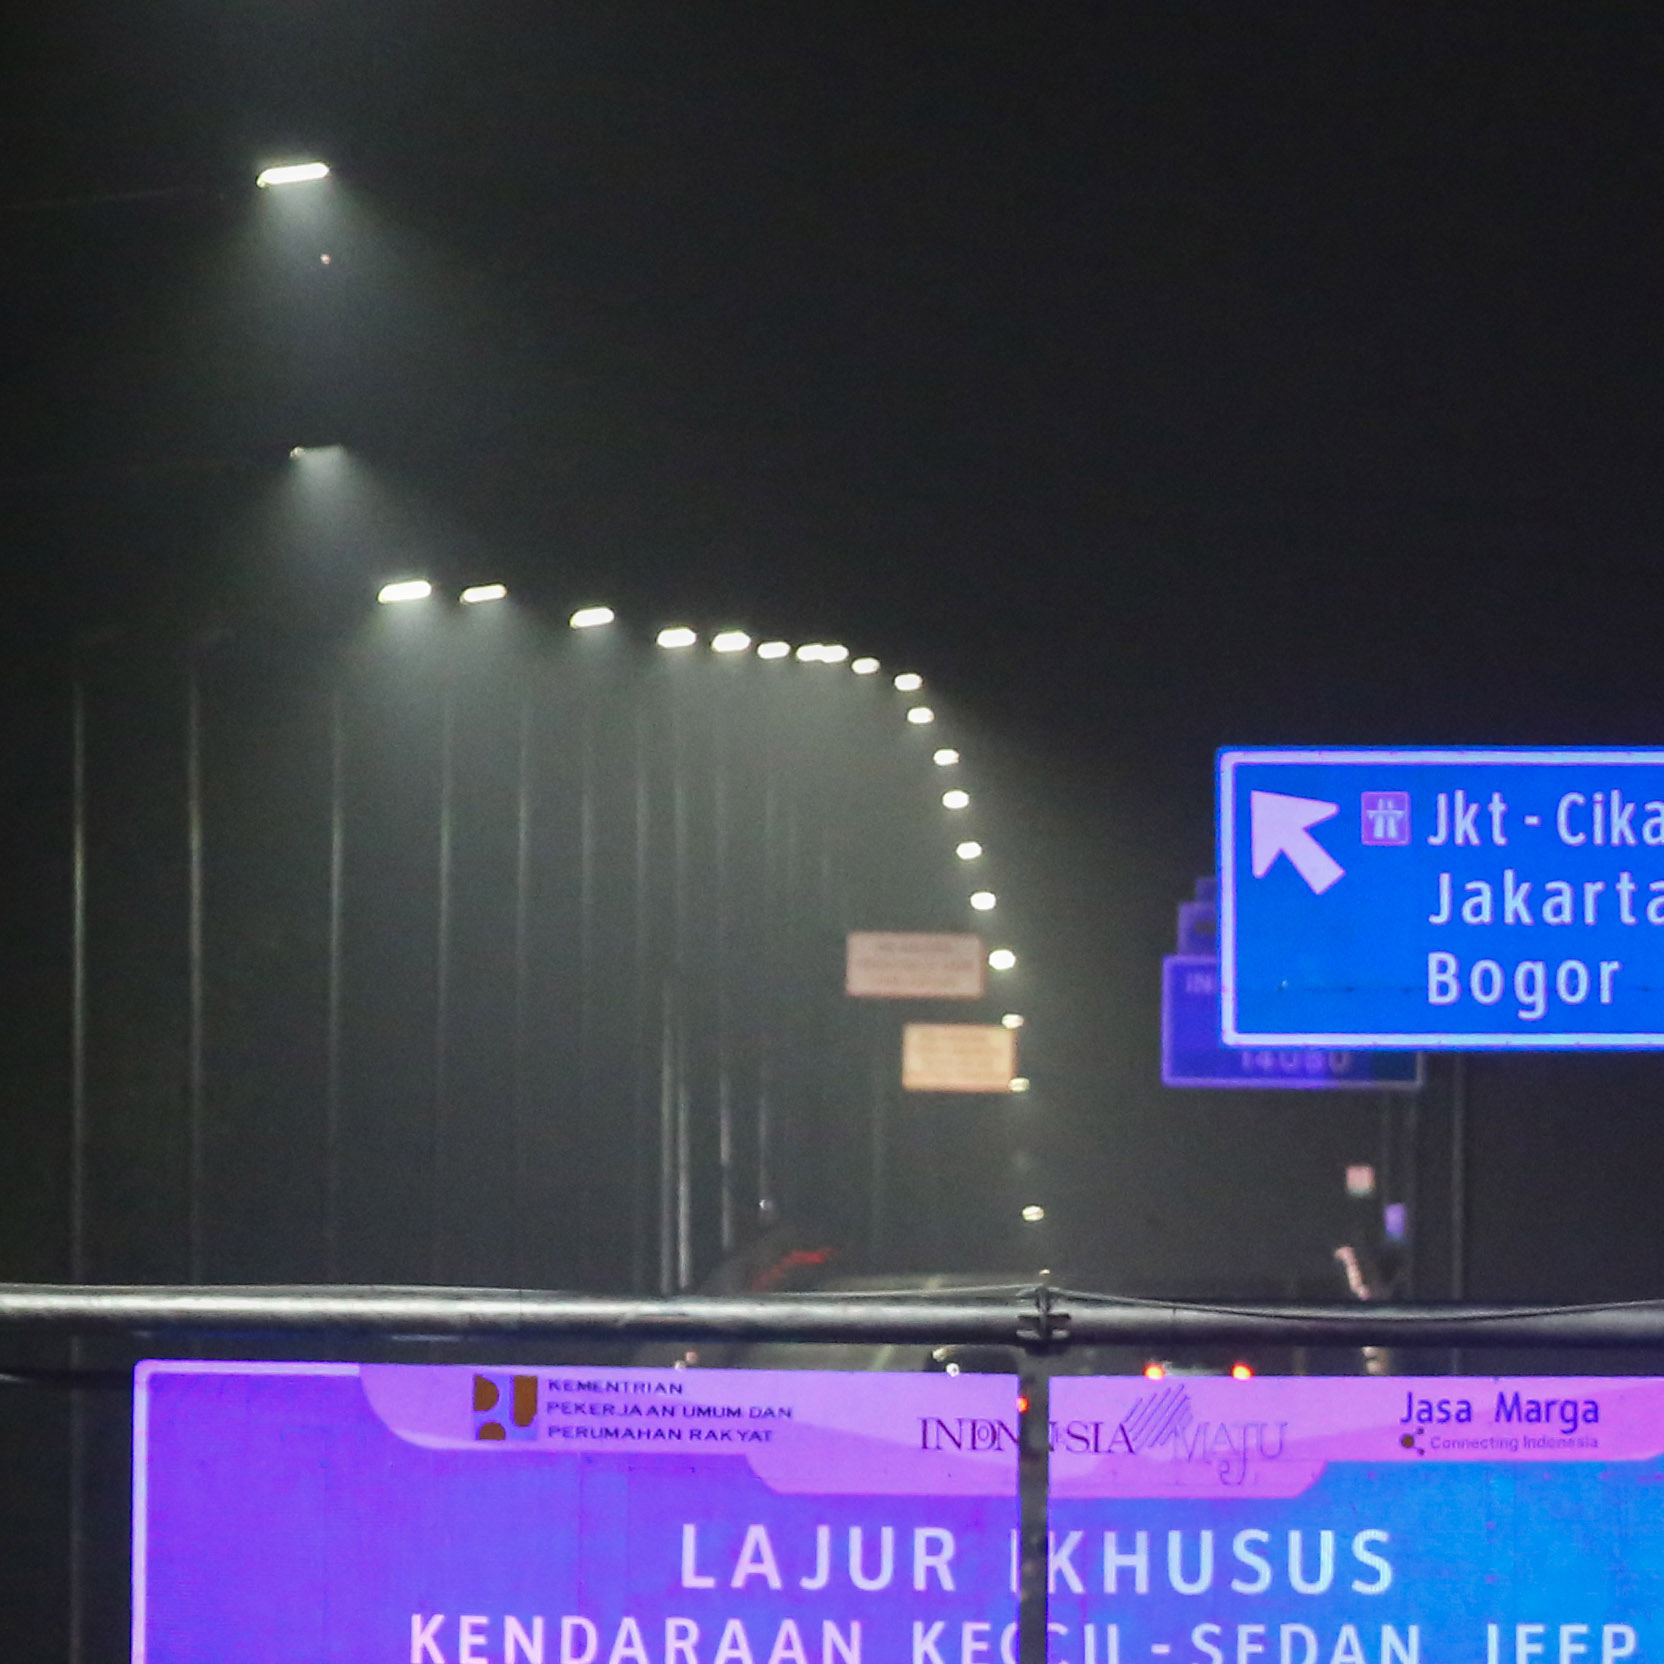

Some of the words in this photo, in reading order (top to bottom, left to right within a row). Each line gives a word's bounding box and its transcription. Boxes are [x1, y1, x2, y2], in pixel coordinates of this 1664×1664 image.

[1427, 791, 1508, 847] Jkt
[1427, 951, 1622, 1020] Bogor
[547, 1378, 683, 1395] KEMENTRIAN
[546, 1401, 676, 1419] PEKERJAAN
[682, 1404, 742, 1419] UMUM
[748, 1406, 792, 1420] DAN
[1400, 1390, 1472, 1424] Jasa
[1495, 1390, 1600, 1435] Marga
[547, 1424, 682, 1441] PERUMAHAN
[688, 1427, 774, 1443] RAKYAT
[1429, 1435, 1519, 1451] Connecting
[1522, 1435, 1600, 1449] Indonesia
[680, 1522, 957, 1592] LAJUR
[1009, 1527, 1396, 1596] KHUSUS
